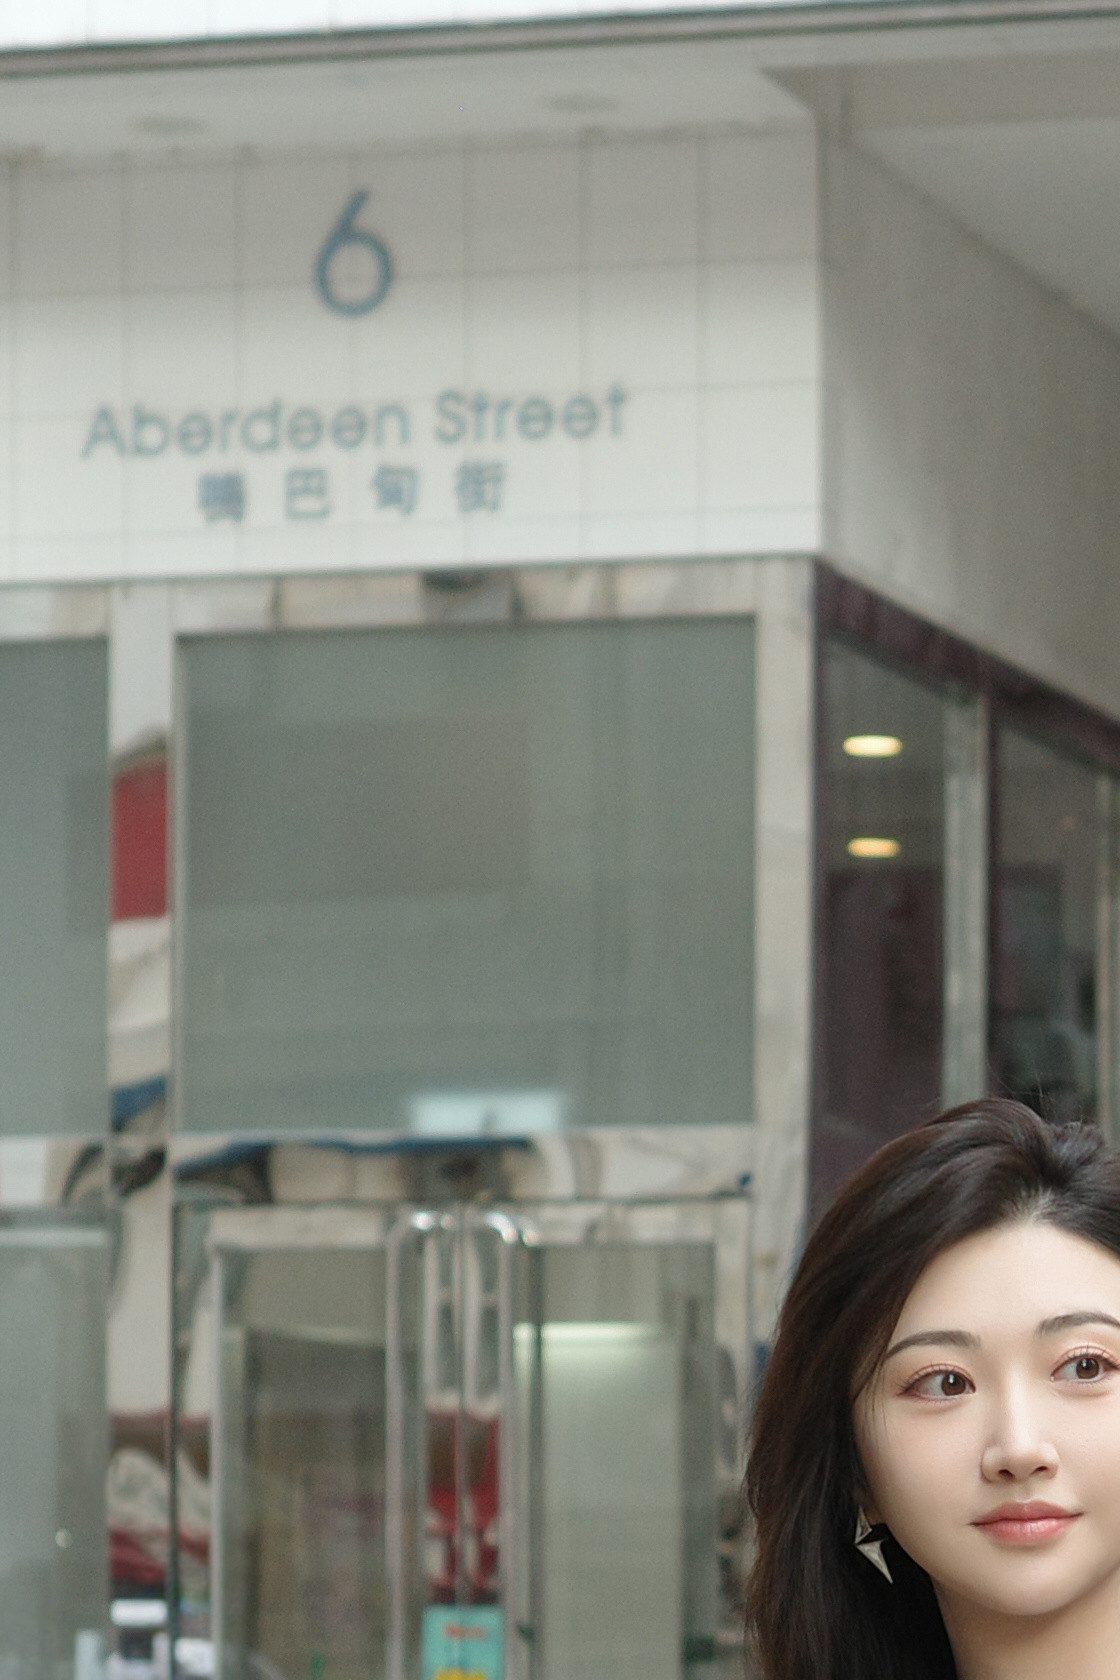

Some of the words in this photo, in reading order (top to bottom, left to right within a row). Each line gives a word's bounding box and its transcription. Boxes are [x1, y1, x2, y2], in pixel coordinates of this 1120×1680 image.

[315, 189, 395, 318] 6
[81, 398, 412, 458] Aberdeen
[433, 385, 630, 445] Street
